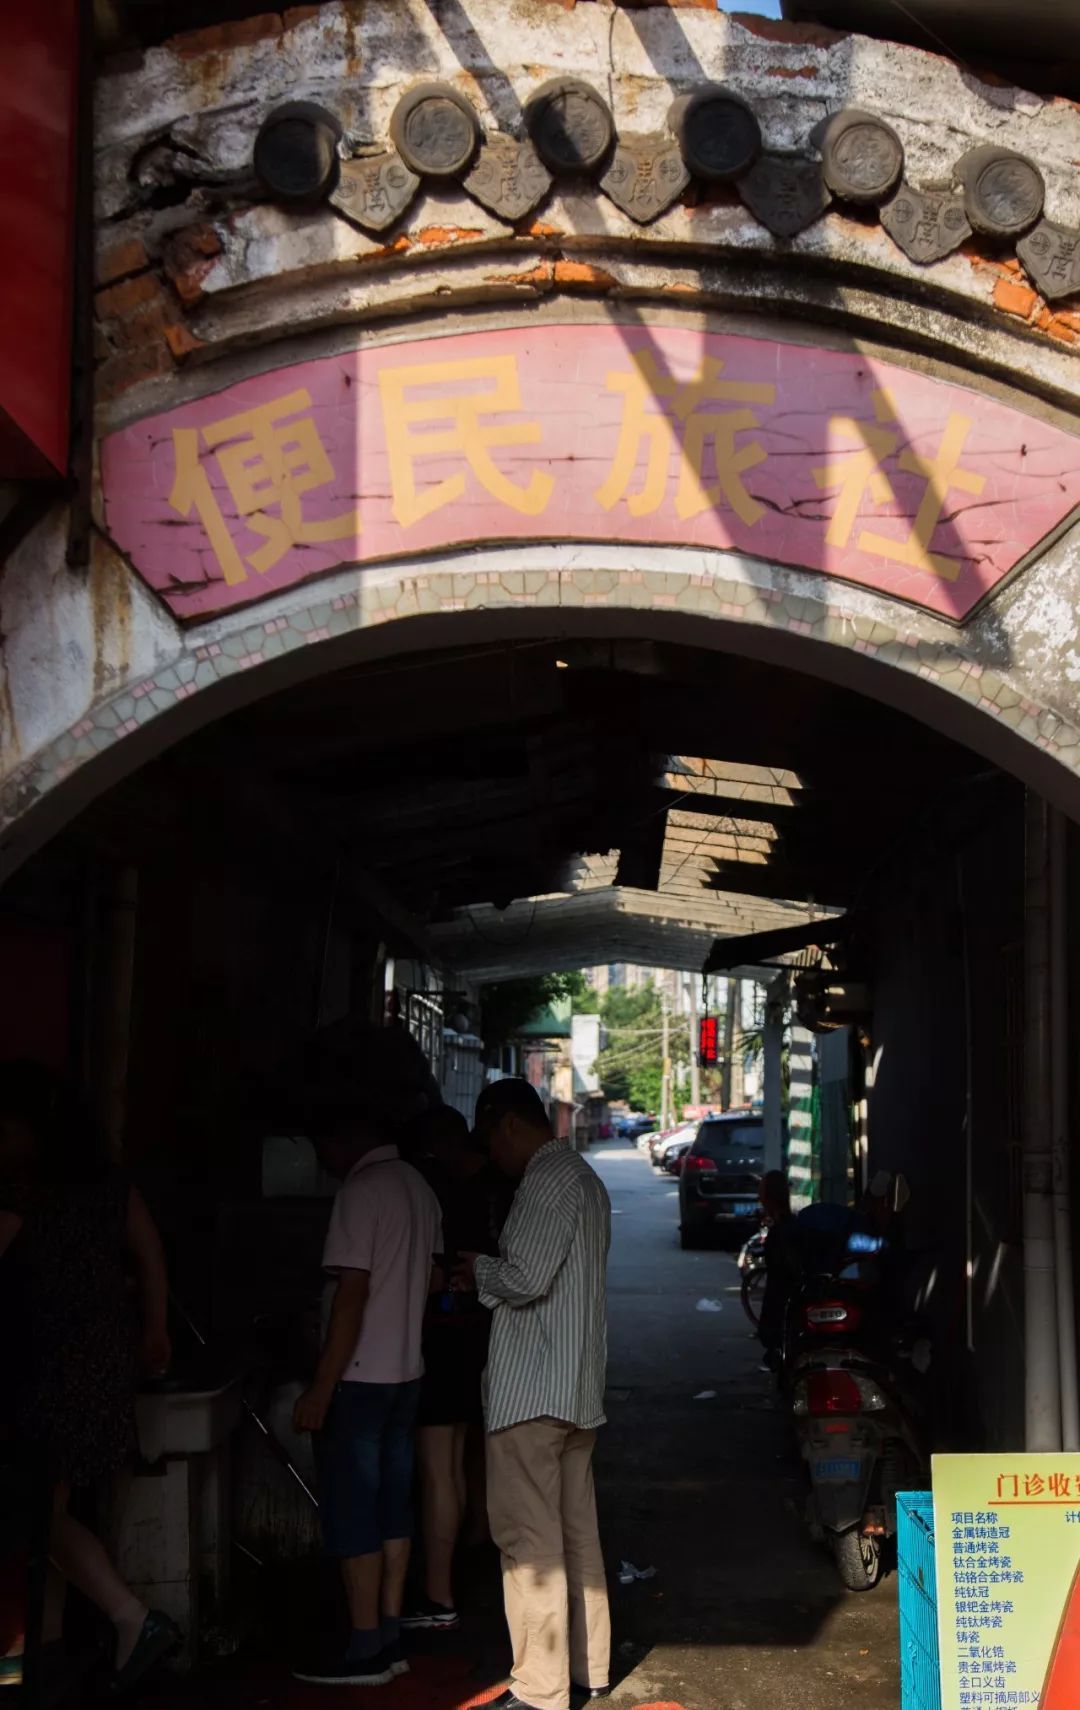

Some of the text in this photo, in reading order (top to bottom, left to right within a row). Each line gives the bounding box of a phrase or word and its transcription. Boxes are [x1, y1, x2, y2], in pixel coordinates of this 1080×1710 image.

[169, 350, 986, 586] 便民旅社
[996, 1472, 1080, 1498] 门诊收
[951, 1511, 998, 1524] 项目名称
[1064, 1510, 1080, 1523] 计
[952, 1526, 1010, 1539] 金属铸造冠
[952, 1541, 999, 1554] 普通烤瓷
[953, 1556, 1011, 1569] 钛合金烤瓷
[953, 1570, 1024, 1583] 钴铬合金烤瓷
[954, 1586, 989, 1599] 纯钛冠
[955, 1600, 1014, 1613] 银钯金烤瓷
[955, 1615, 1002, 1628] 纯钛烤瓷
[956, 1631, 980, 1643] 铸瓷
[957, 1646, 1004, 1659] 二氧化锆
[958, 1660, 1017, 1673] 贵金属烤瓷
[959, 1676, 1005, 1689] 全口义齿
[960, 1691, 1041, 1704] 塑料可摘局部义
